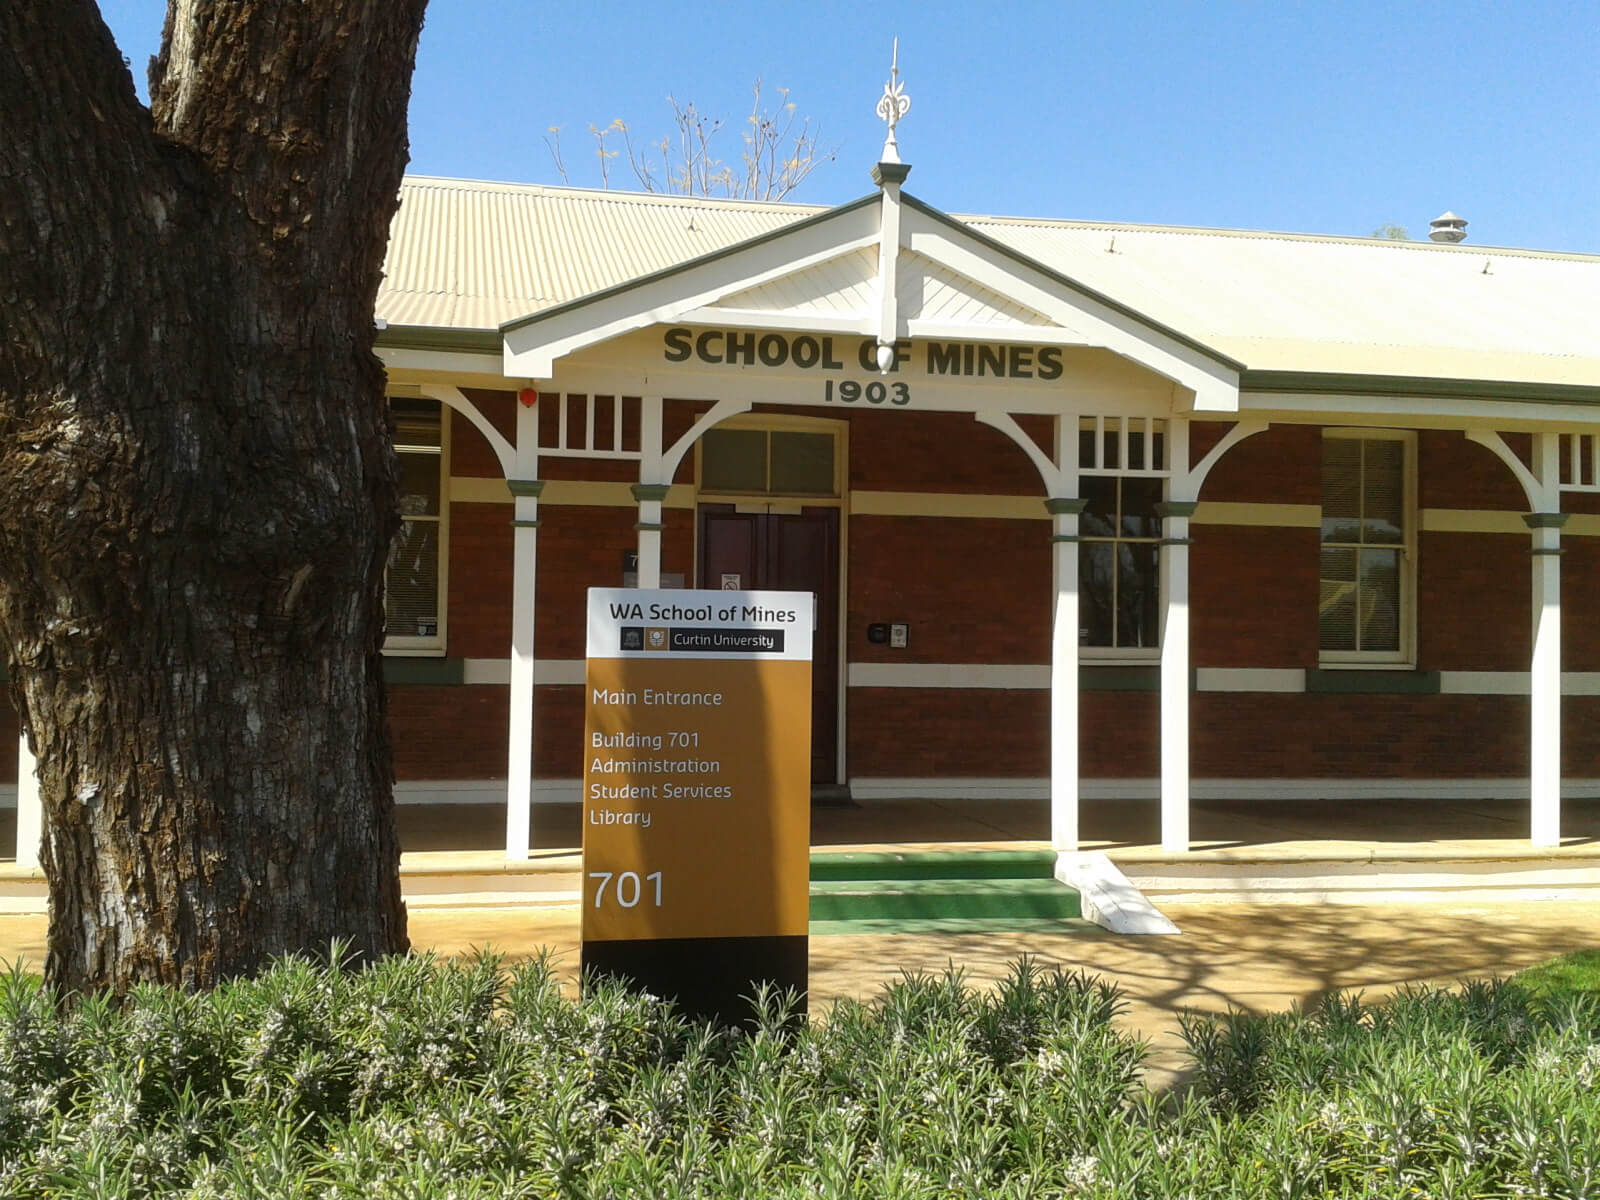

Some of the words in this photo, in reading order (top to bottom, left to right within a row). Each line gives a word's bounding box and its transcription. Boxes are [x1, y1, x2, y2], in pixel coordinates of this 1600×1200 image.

[663, 328, 844, 370] SCHOOL
[858, 336, 913, 373] OF
[926, 342, 1064, 380] MINES
[824, 379, 911, 405] 1903
[609, 603, 643, 620] WA
[649, 603, 712, 622] School
[718, 605, 737, 621] of
[742, 605, 796, 623] Mines
[673, 633, 711, 646] Curtin
[713, 634, 774, 649] University
[593, 688, 637, 705] Main
[643, 689, 723, 705] Entrance
[592, 732, 662, 750] Building
[668, 732, 700, 748] 701
[590, 758, 720, 774] Administration
[590, 783, 657, 799] Student
[663, 783, 732, 799] Services
[590, 809, 651, 827] Library
[589, 871, 662, 908] 701
